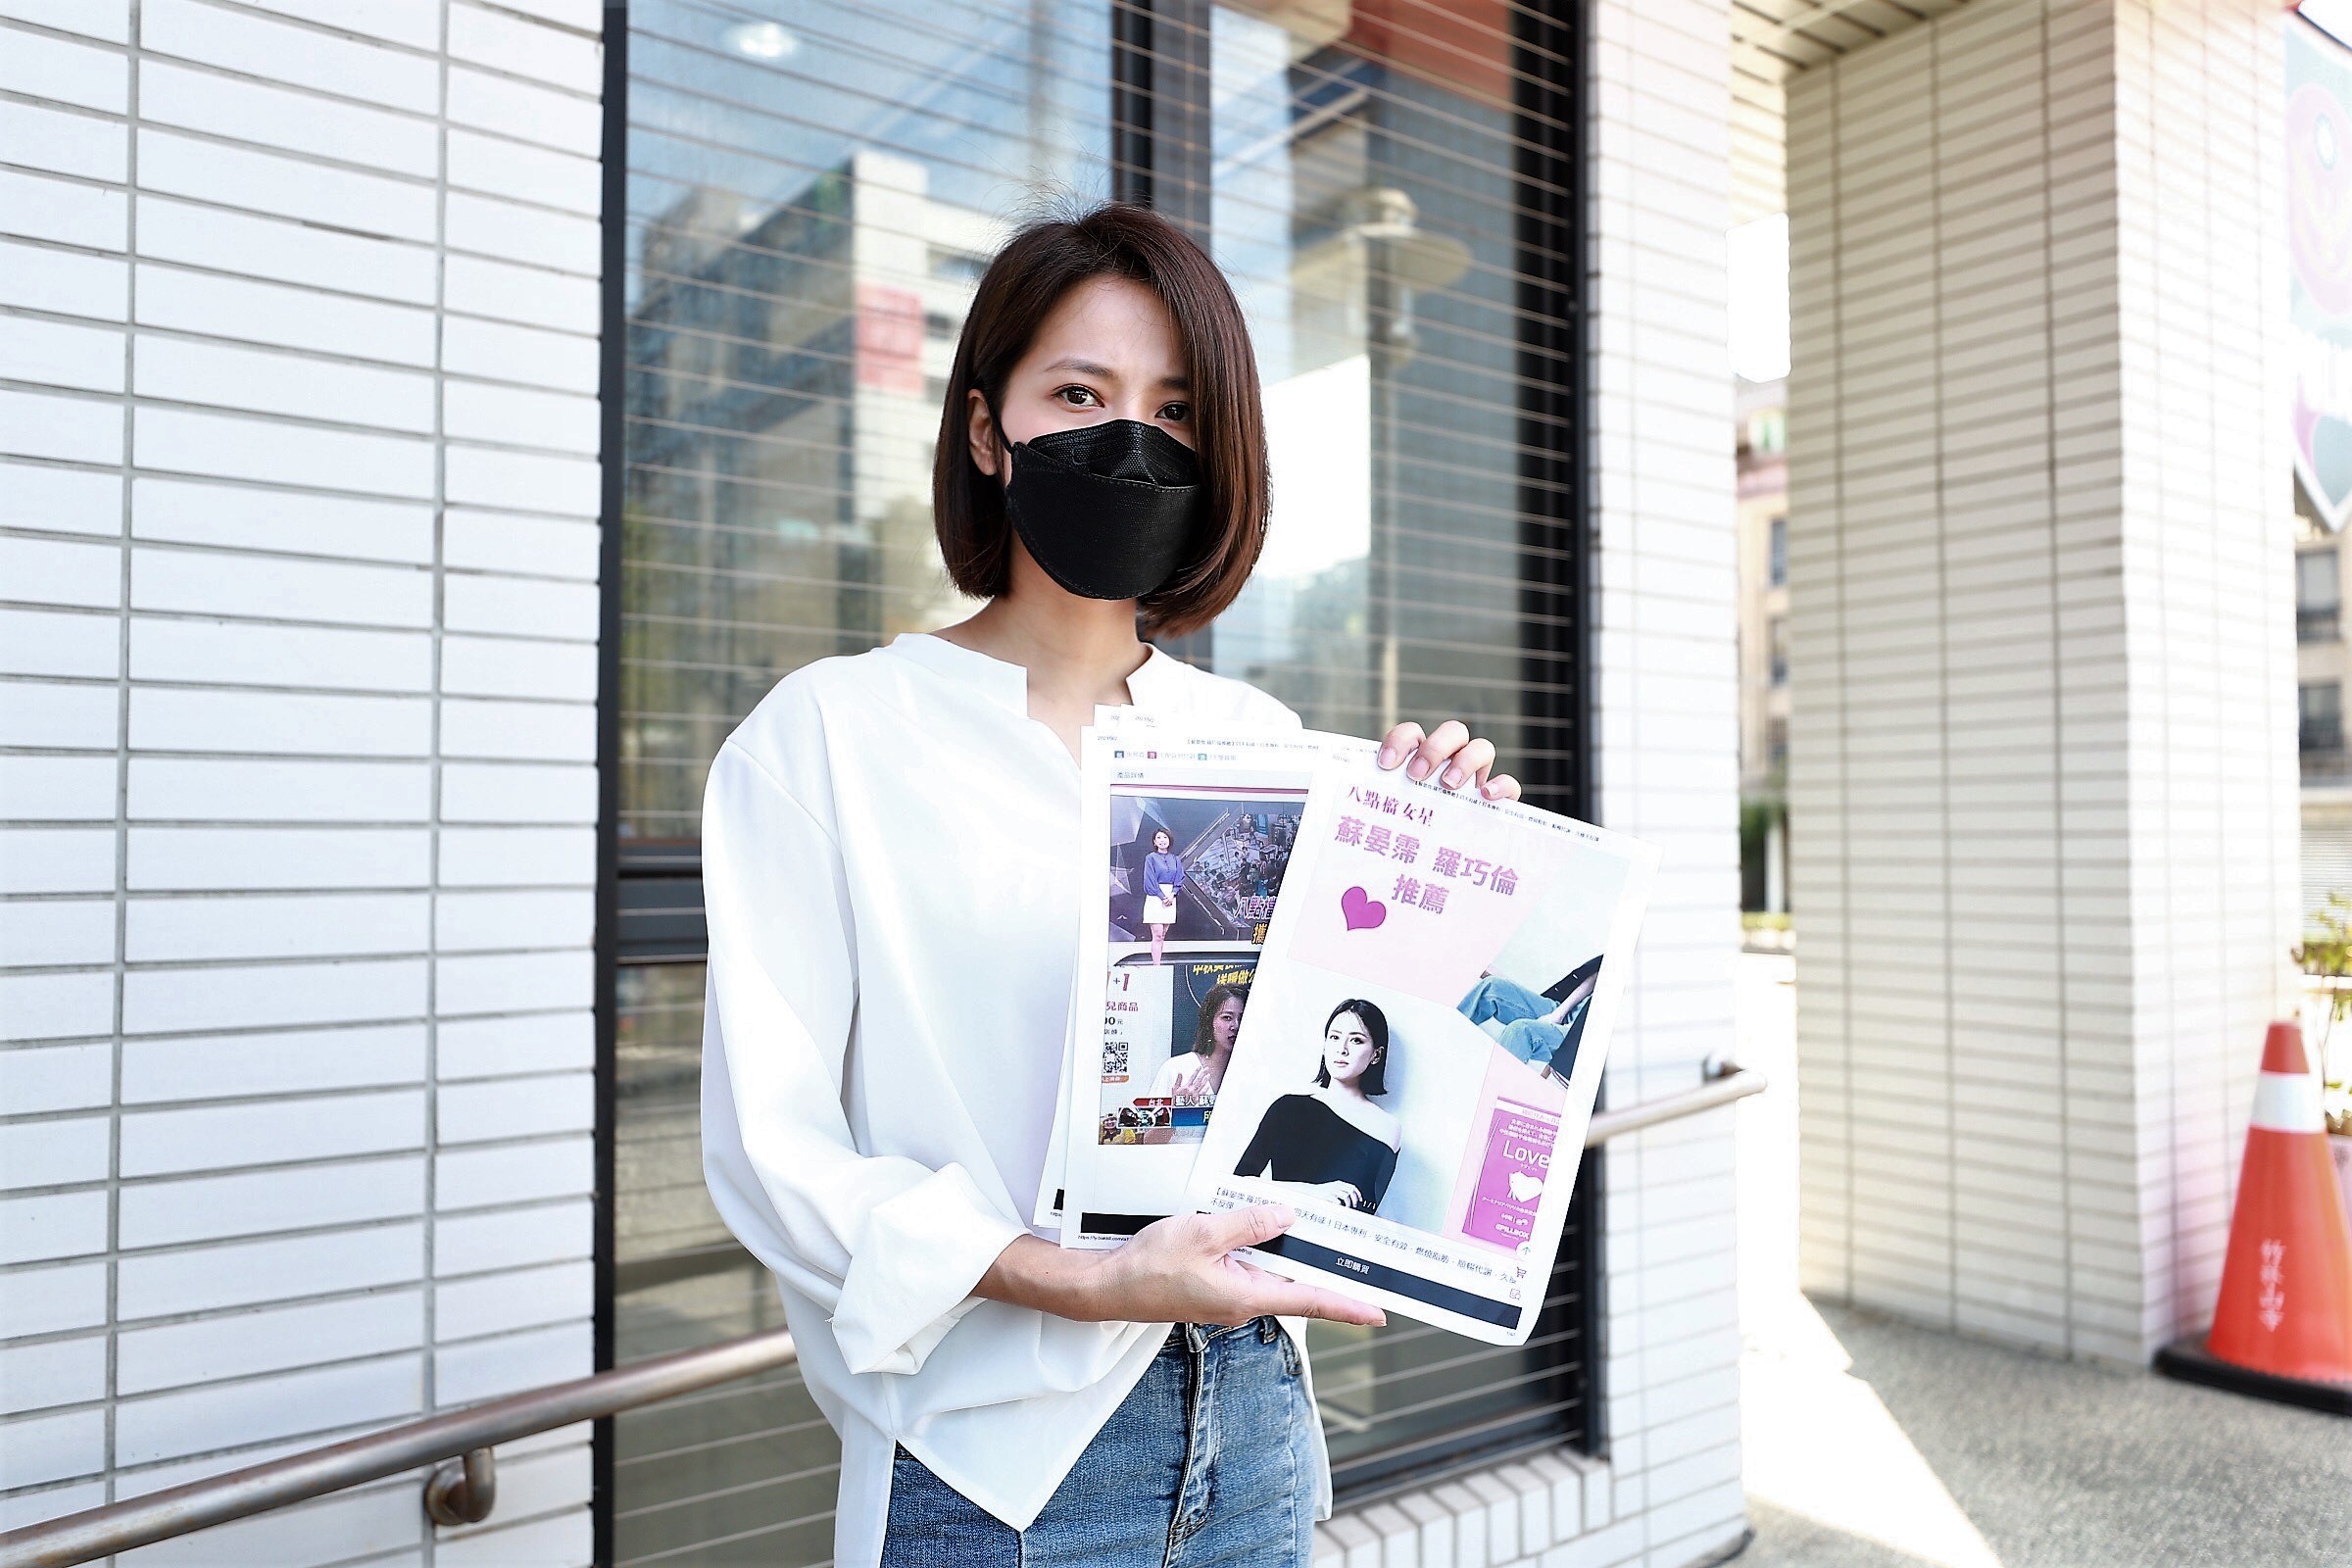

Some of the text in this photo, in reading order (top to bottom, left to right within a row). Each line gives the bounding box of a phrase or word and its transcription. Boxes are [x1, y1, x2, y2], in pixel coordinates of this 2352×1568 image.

[1348, 785, 1434, 827] 八點檔女星
[1334, 815, 1519, 896] 蘇晏霈 羅巧倫
[1391, 874, 1450, 914] 推薦
[1336, 1255, 1370, 1276] 立即購買
